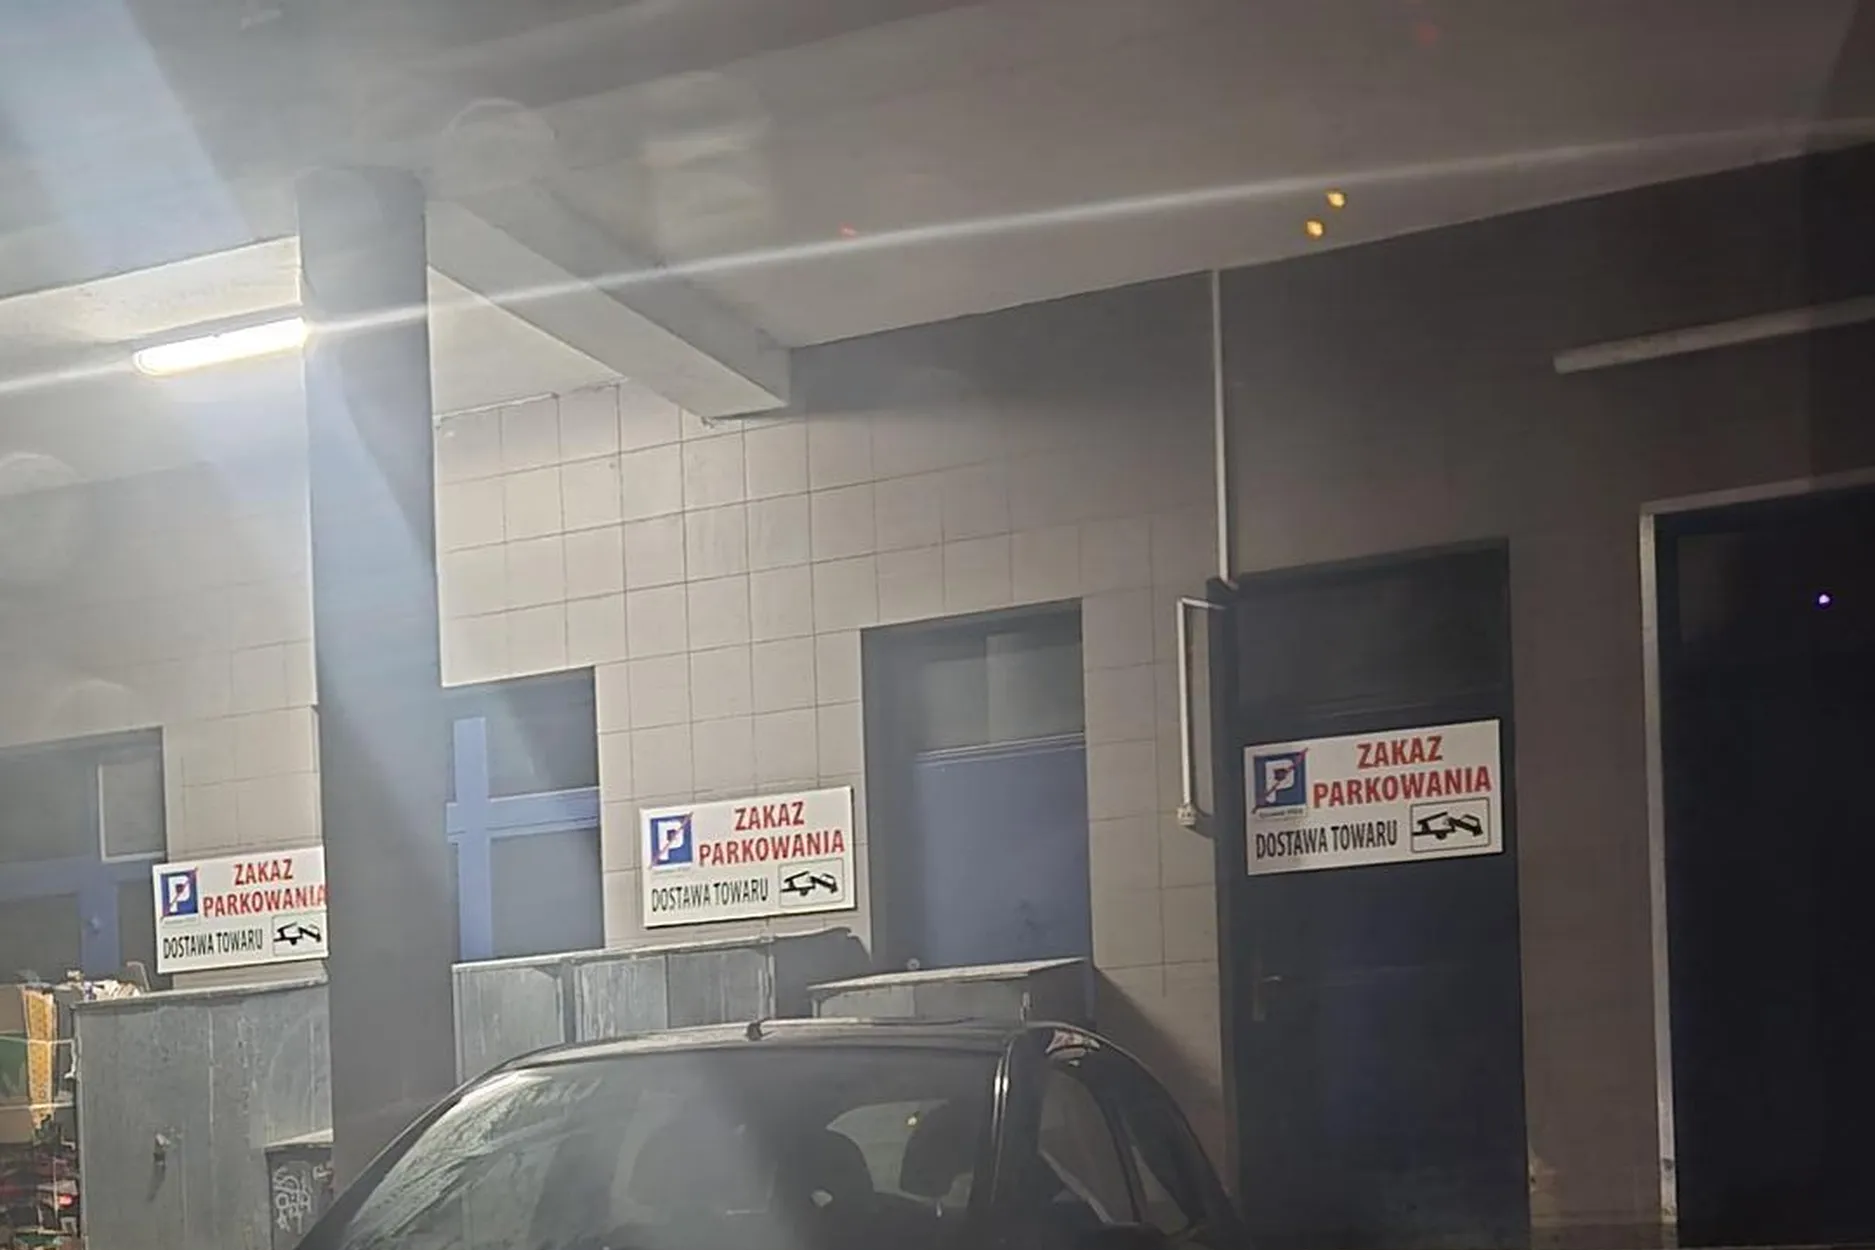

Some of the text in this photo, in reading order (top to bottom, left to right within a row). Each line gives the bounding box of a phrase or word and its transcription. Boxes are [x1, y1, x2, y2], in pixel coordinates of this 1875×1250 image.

[1357, 735, 1443, 770] ZAKAZ
[1313, 765, 1492, 809] PARKOWANIA
[734, 801, 805, 832] ZAKAZ
[698, 829, 845, 867] PARKOWANIA
[1256, 819, 1398, 861] DOSTAWA TOWARU
[234, 858, 293, 885] ZAKAZ
[203, 884, 328, 918] PARKOWANIA
[651, 877, 769, 912] DOSTAWA TOWARU
[163, 928, 263, 959] DOSTAWA TOWARU
